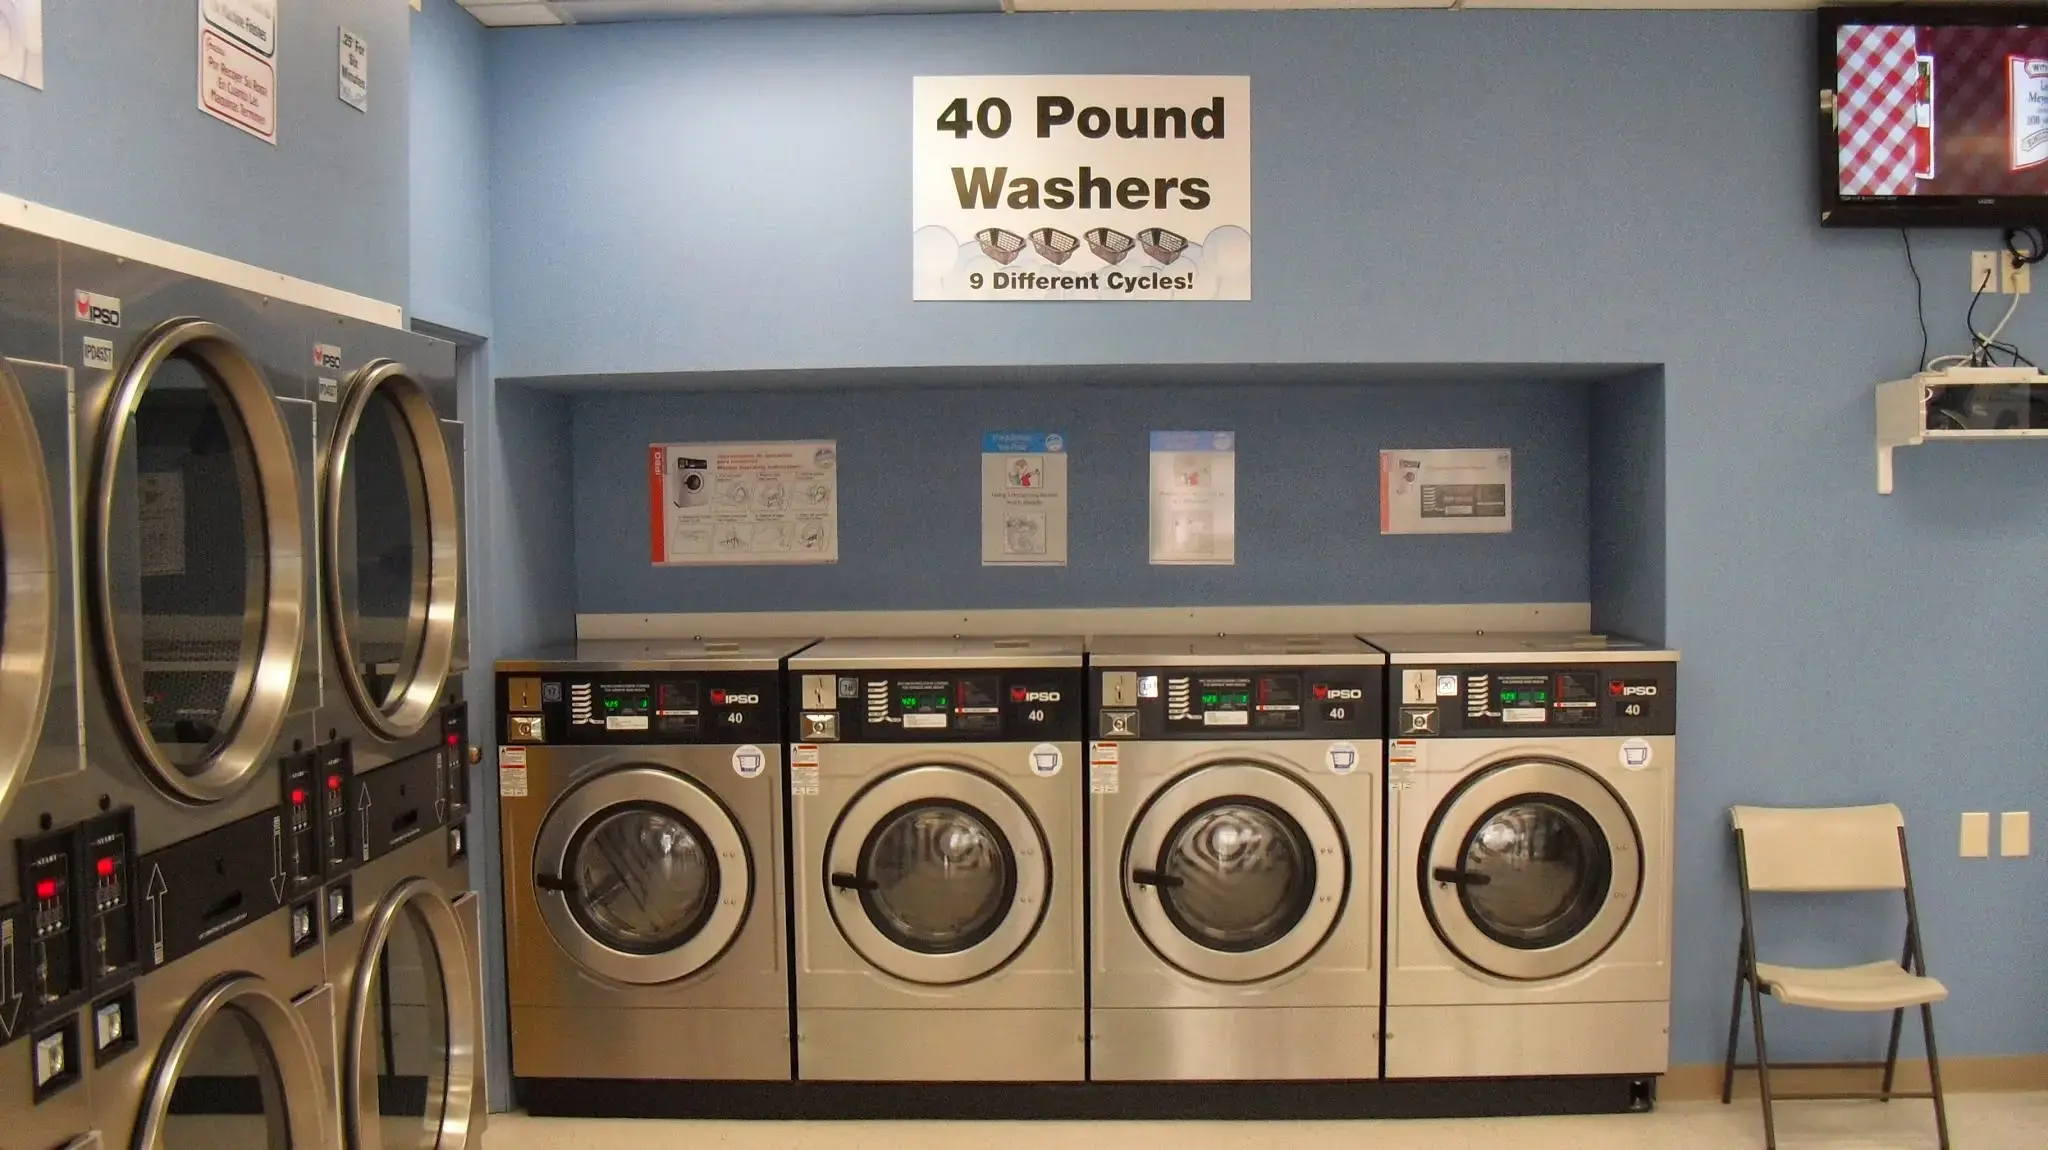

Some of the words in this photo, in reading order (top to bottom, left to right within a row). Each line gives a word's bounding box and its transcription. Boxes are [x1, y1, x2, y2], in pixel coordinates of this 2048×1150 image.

[937, 97, 1012, 139] 40
[1037, 96, 1225, 140] Pound
[951, 166, 1211, 210] Washers
[970, 272, 984, 290] 9
[993, 272, 1099, 290] Different
[1107, 271, 1193, 293] Cycles!
[90, 306, 119, 326] IPSO
[654, 451, 662, 476] IPSO
[1025, 691, 1061, 702] IPSO
[1327, 689, 1362, 700] IPSO
[1623, 686, 1657, 696] IPSO
[725, 694, 759, 704] IPSO
[1028, 709, 1044, 722] 40
[1329, 707, 1345, 719] 40
[1625, 704, 1641, 716] 40
[727, 712, 743, 724] 40
